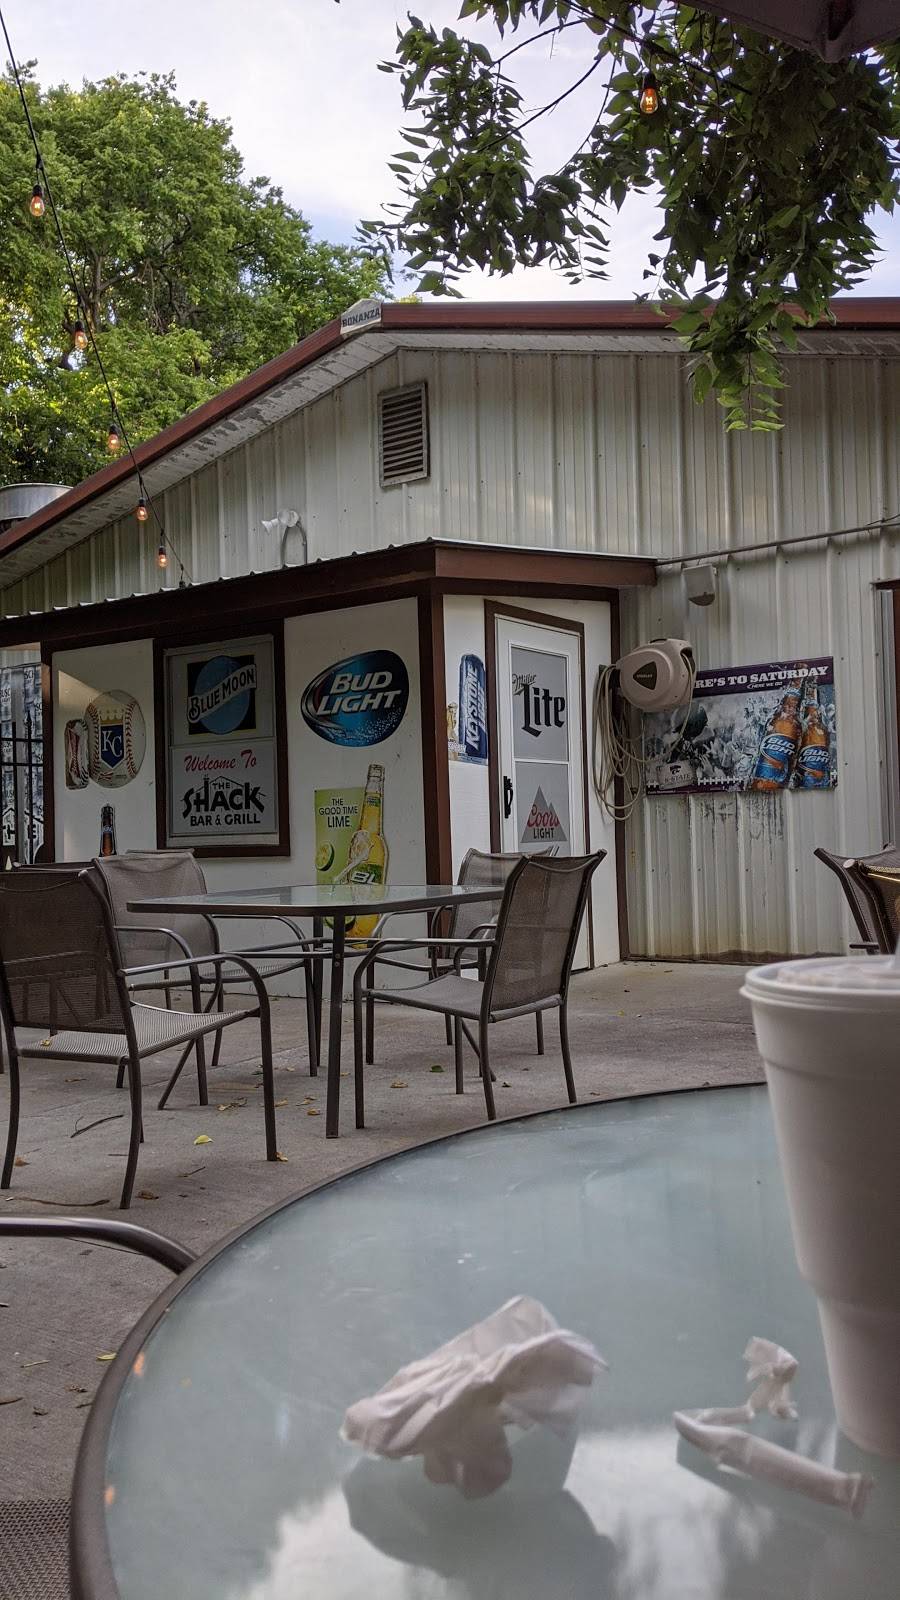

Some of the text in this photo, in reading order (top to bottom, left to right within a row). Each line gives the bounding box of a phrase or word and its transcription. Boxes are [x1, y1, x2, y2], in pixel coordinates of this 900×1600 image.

[342, 308, 380, 327] BONANZA
[330, 671, 393, 695] BUD
[695, 666, 829, 689] RE'S TO SATURDAY
[189, 668, 255, 721] BLUE MOON
[316, 690, 402, 716] LIGHT
[465, 663, 480, 751] KEYSTONE
[521, 683, 566, 738] Lite
[102, 730, 123, 758] KC
[761, 743, 795, 756] LIGHT
[767, 737, 796, 750] BUD
[803, 748, 829, 757] BUD
[184, 749, 257, 772] Welcome To
[800, 755, 829, 763] LIGHT
[182, 778, 265, 819] SHACK
[332, 798, 344, 806] THE
[190, 813, 261, 827] BAR & GRILL
[319, 806, 358, 816] GOOD TIME
[527, 804, 560, 828] Coors
[533, 827, 554, 839] LIGHT
